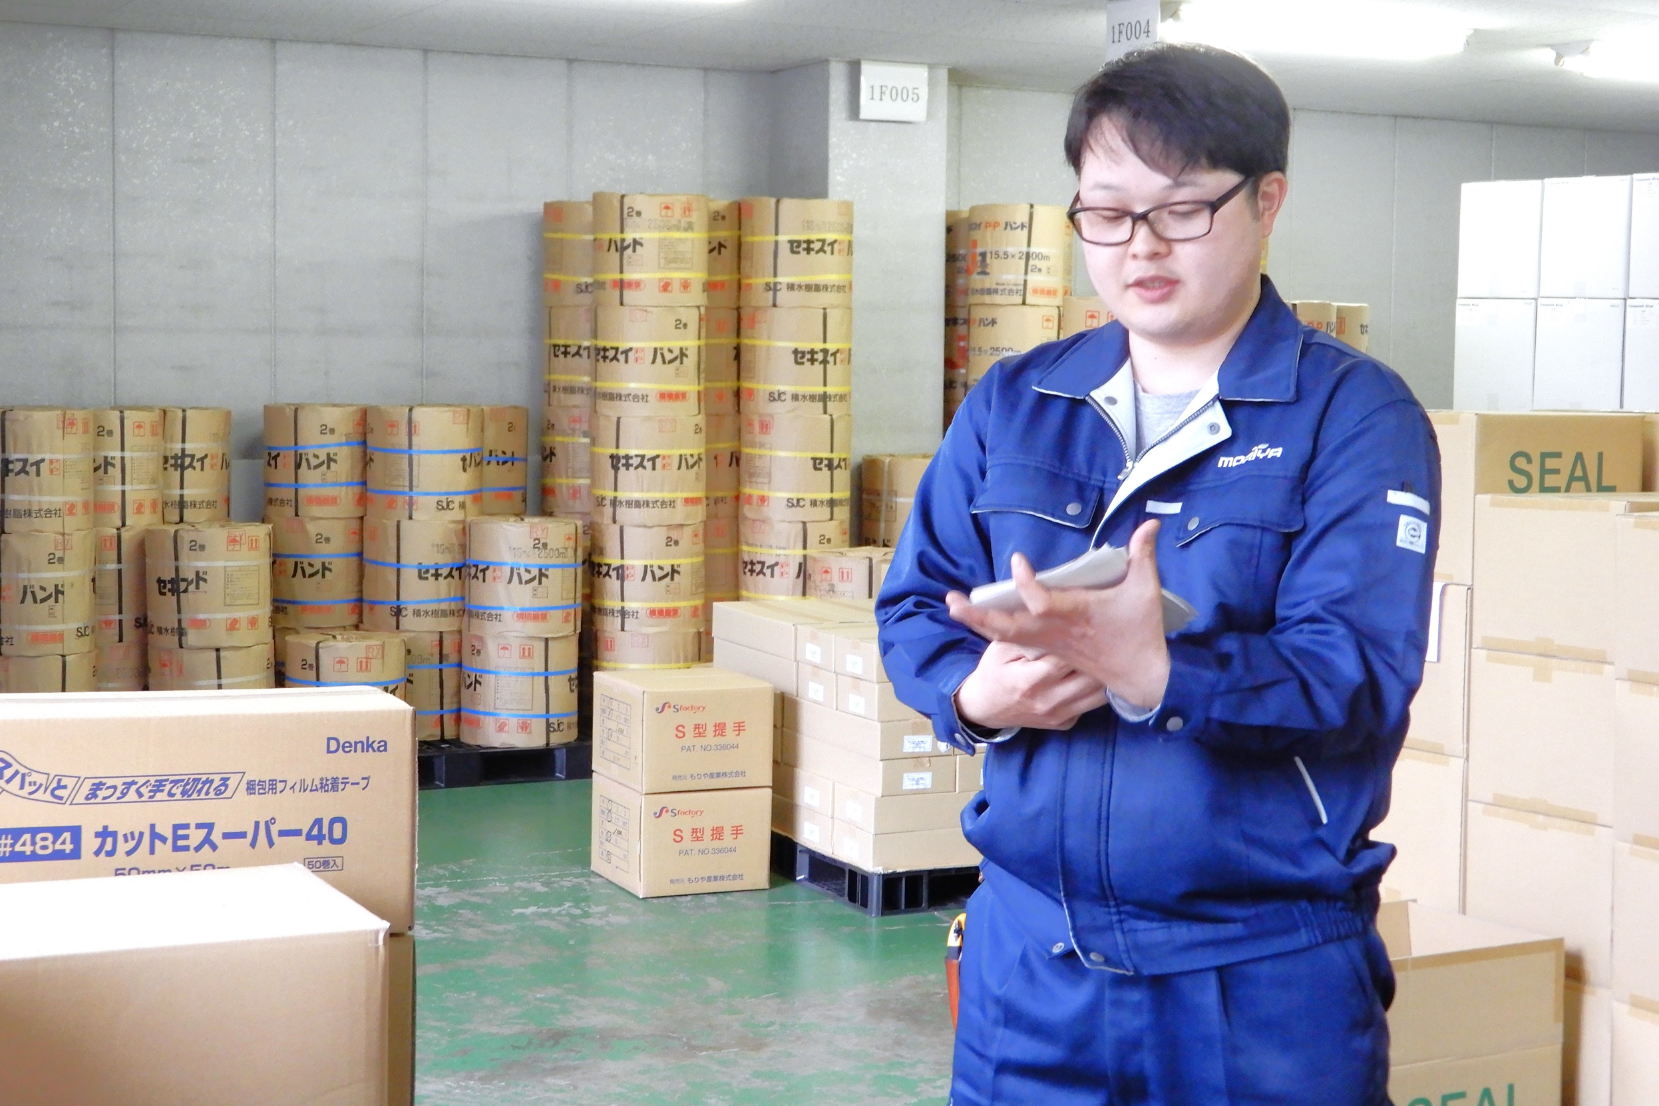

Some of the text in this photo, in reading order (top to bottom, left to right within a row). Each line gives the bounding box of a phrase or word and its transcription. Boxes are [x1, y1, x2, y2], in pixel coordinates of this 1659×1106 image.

[1111, 19, 1151, 44] 1F004
[869, 85, 920, 103] 1F005
[787, 239, 837, 256] セキスイ
[650, 347, 689, 366] バンド
[792, 347, 840, 366] セキスイ
[297, 452, 338, 471] バンド
[608, 454, 661, 471] セキスイ
[1507, 450, 1617, 494] SEAL
[291, 561, 333, 579] バンド
[507, 566, 549, 585] バンド
[640, 565, 681, 582] バンド
[326, 736, 388, 754] Denka
[0, 757, 68, 801] スパッと
[84, 776, 232, 801] まっすぐ手で切れる
[246, 775, 371, 796] 梱包用フィルム粘着テープ
[0, 831, 74, 857] #484
[93, 816, 348, 858] カットEスーパー40
[307, 858, 339, 869] 50巻入
